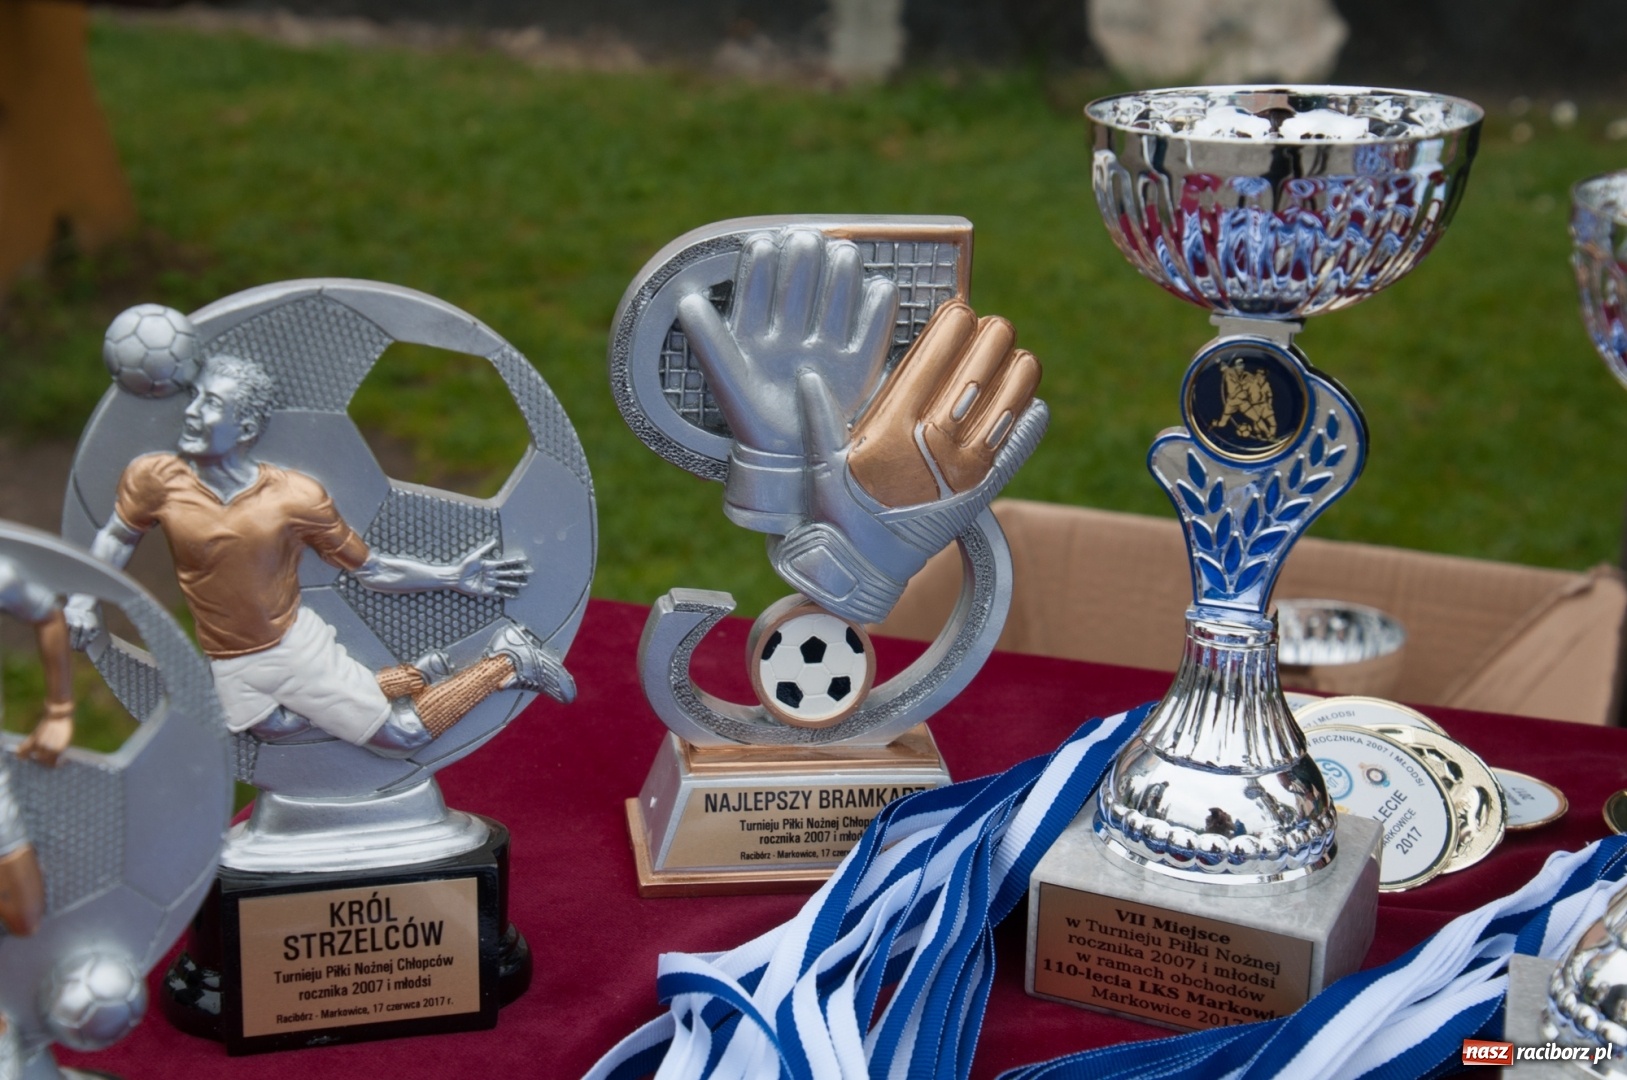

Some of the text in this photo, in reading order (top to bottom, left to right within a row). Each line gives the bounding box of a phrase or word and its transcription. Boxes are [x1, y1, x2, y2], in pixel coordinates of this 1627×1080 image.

[1317, 710, 1356, 723] MŁODSI
[1312, 734, 1363, 746] ROCZNIKA
[1366, 740, 1388, 753] 2007
[1394, 755, 1425, 787] MŁODSI
[704, 787, 926, 813] NAJLEPSZY BRAMKA
[740, 820, 779, 833] Turnieju
[782, 818, 804, 830] Piłki
[806, 817, 839, 831] Nożnej
[759, 832, 800, 844] rocznika
[804, 831, 831, 843] 2007
[833, 831, 837, 841] i
[1382, 808, 1416, 848] ARKOWICE
[1395, 826, 1422, 855] 2017
[740, 851, 771, 860] Racibórz
[777, 850, 819, 859] Markowice,
[822, 849, 831, 857] 17
[329, 891, 398, 928] KRÓL
[1114, 908, 1230, 945] VII Miejsce
[283, 916, 445, 962] STRZELCÓW
[1065, 917, 1281, 976] w Turnieju Piłki Nożnej
[274, 954, 454, 984] Turnieju Piłki Nożnej Chłopców
[1067, 933, 1276, 990] rocznika 2007 i młodsi
[1076, 951, 1265, 1003] w ramach obchodów
[299, 974, 432, 1002] rocznika 2007 i młodsi
[1042, 957, 1283, 1020] 110-lecia LKS Markowi
[1091, 985, 1192, 1020] Markowice
[276, 1011, 313, 1025] Racibórz
[320, 1004, 370, 1020] Markowice,
[373, 1003, 384, 1014] 17
[386, 999, 421, 1012] czerwca
[423, 996, 445, 1008] 2017
[447, 996, 454, 1006] r.
